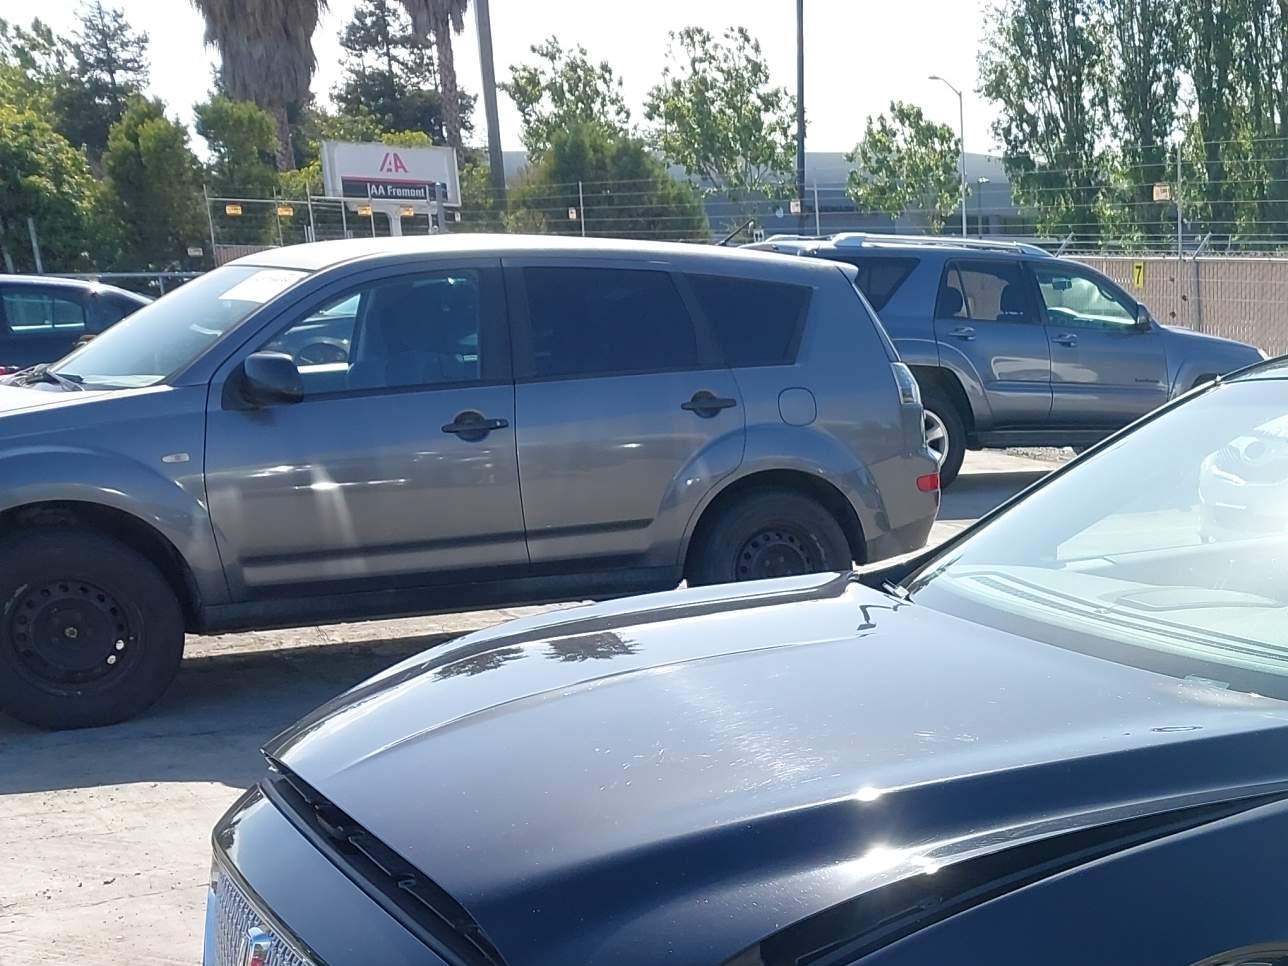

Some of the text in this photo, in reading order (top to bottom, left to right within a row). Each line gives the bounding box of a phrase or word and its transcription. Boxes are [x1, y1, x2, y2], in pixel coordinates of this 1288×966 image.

[367, 184, 425, 198] AA Fremont
[1135, 265, 1142, 285] 7
